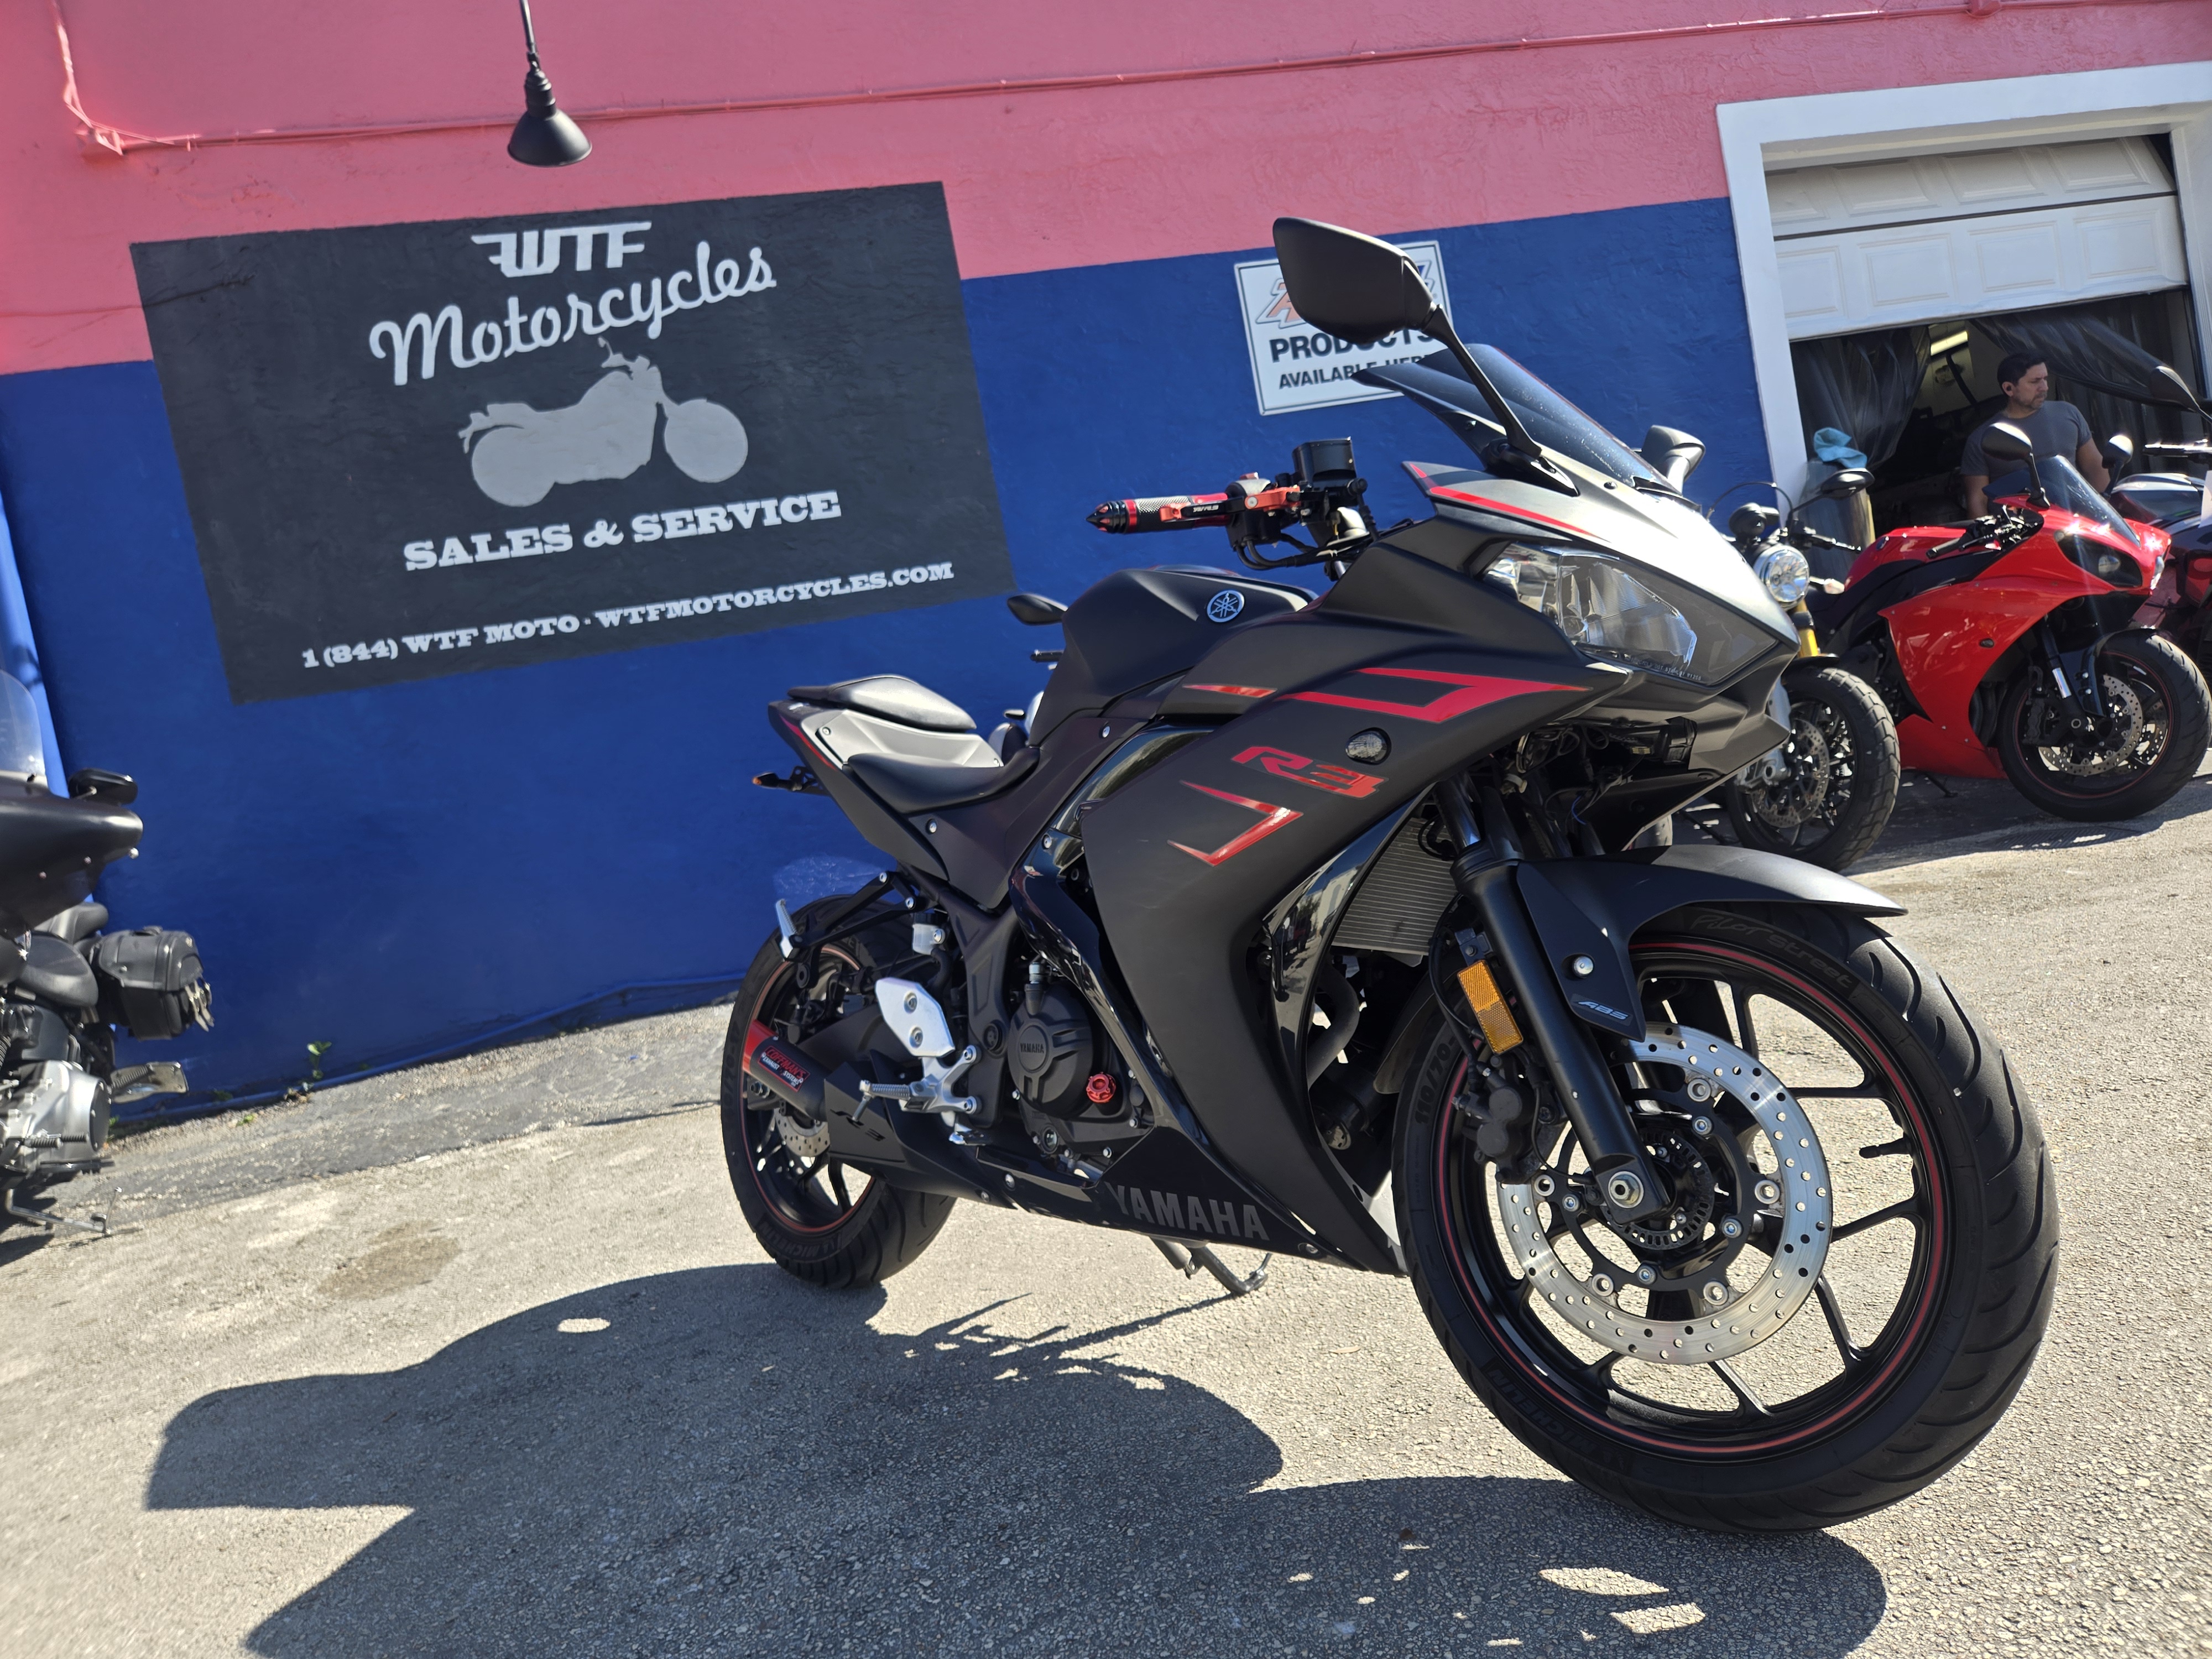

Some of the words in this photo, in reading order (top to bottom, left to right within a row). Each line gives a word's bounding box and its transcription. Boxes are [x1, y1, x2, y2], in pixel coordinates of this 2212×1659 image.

[471, 221, 651, 278] WTF
[369, 241, 777, 386] Motorcycles
[404, 524, 573, 571] SALES
[584, 520, 624, 548] &
[632, 492, 842, 543] SERVICE
[302, 649, 320, 668] 1
[324, 639, 398, 667] (844)
[402, 628, 478, 653] WTF
[483, 614, 580, 644] MOTO
[594, 562, 955, 628] WTFMOTORCYCLES.COM
[1232, 746, 1385, 797] R3
[1578, 1001, 1629, 1020] ABS
[1020, 1043, 1044, 1053] YAMAHA
[1104, 1181, 1270, 1241] YAMAHA
